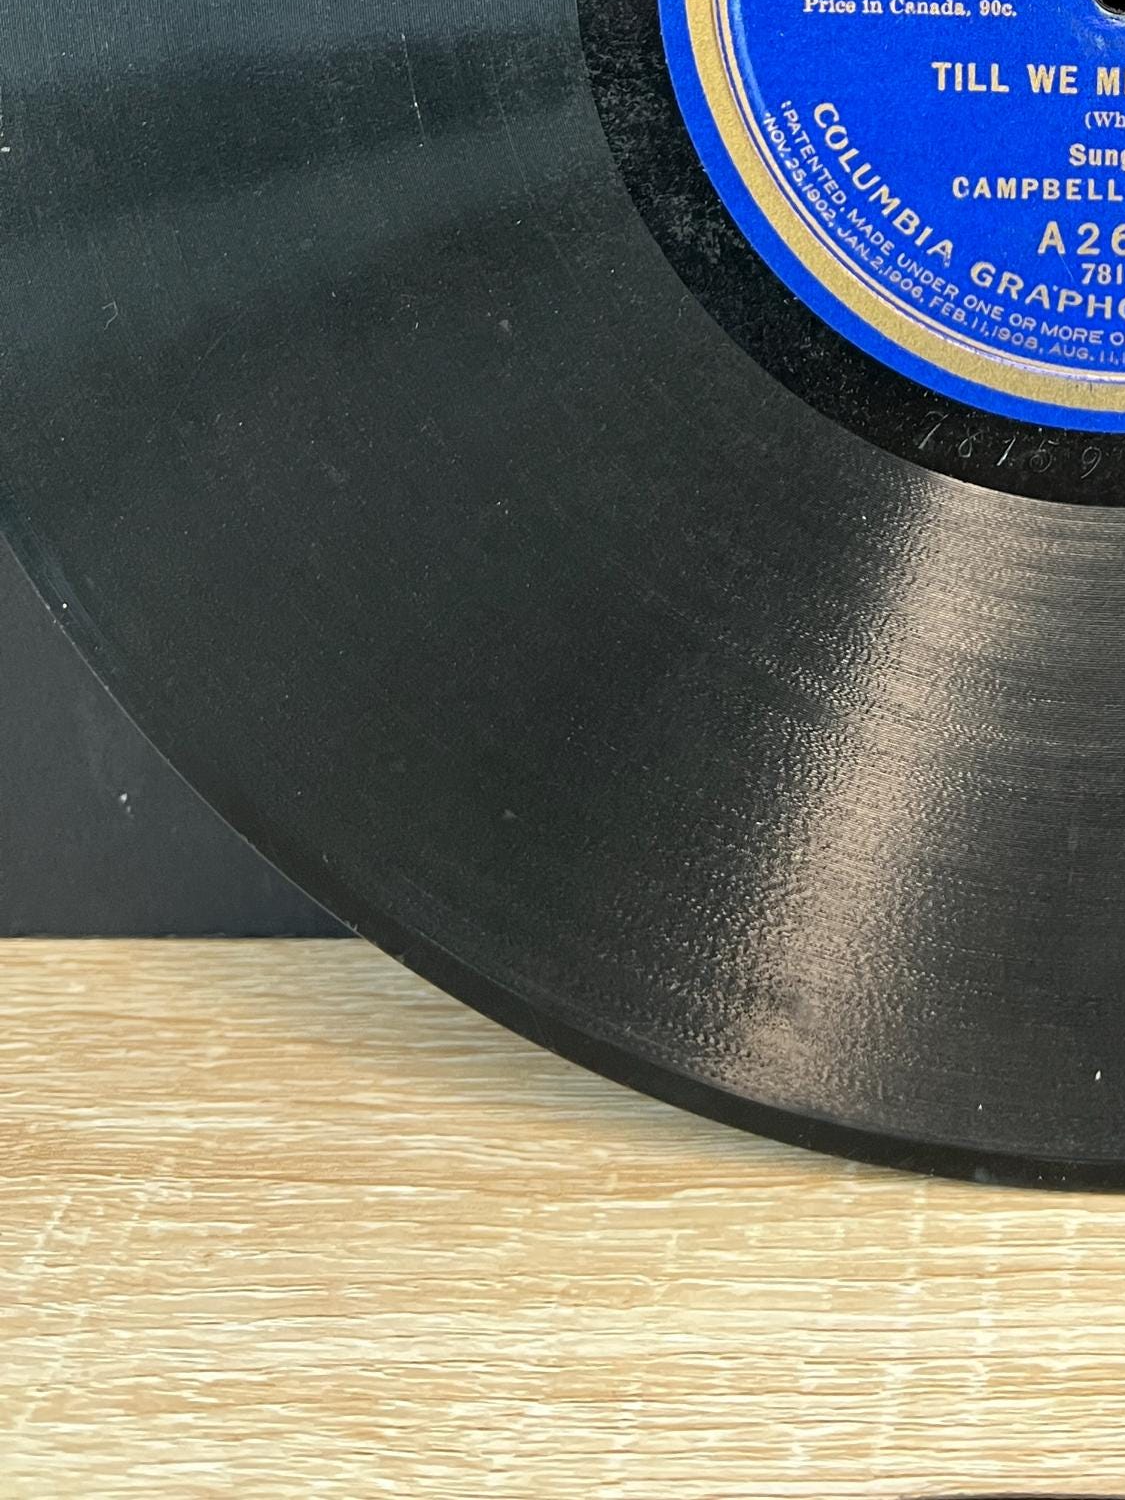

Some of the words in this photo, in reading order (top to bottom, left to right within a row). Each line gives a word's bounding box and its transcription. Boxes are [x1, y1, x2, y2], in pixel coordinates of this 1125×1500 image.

[979, 0, 1017, 17] 90c.
[931, 62, 1010, 93] TILL
[1027, 63, 1078, 94] WE
[813, 102, 954, 268] COLUMBIA
[952, 176, 1124, 202] CAMPBELL
[846, 207, 895, 256] MADE
[896, 252, 960, 301] UNDER
[963, 294, 1005, 322] ONE
[1008, 312, 1037, 332] OR
[1040, 321, 1105, 344] MORE
[928, 295, 968, 327] FEB.
[1049, 341, 1095, 362] AUG.
